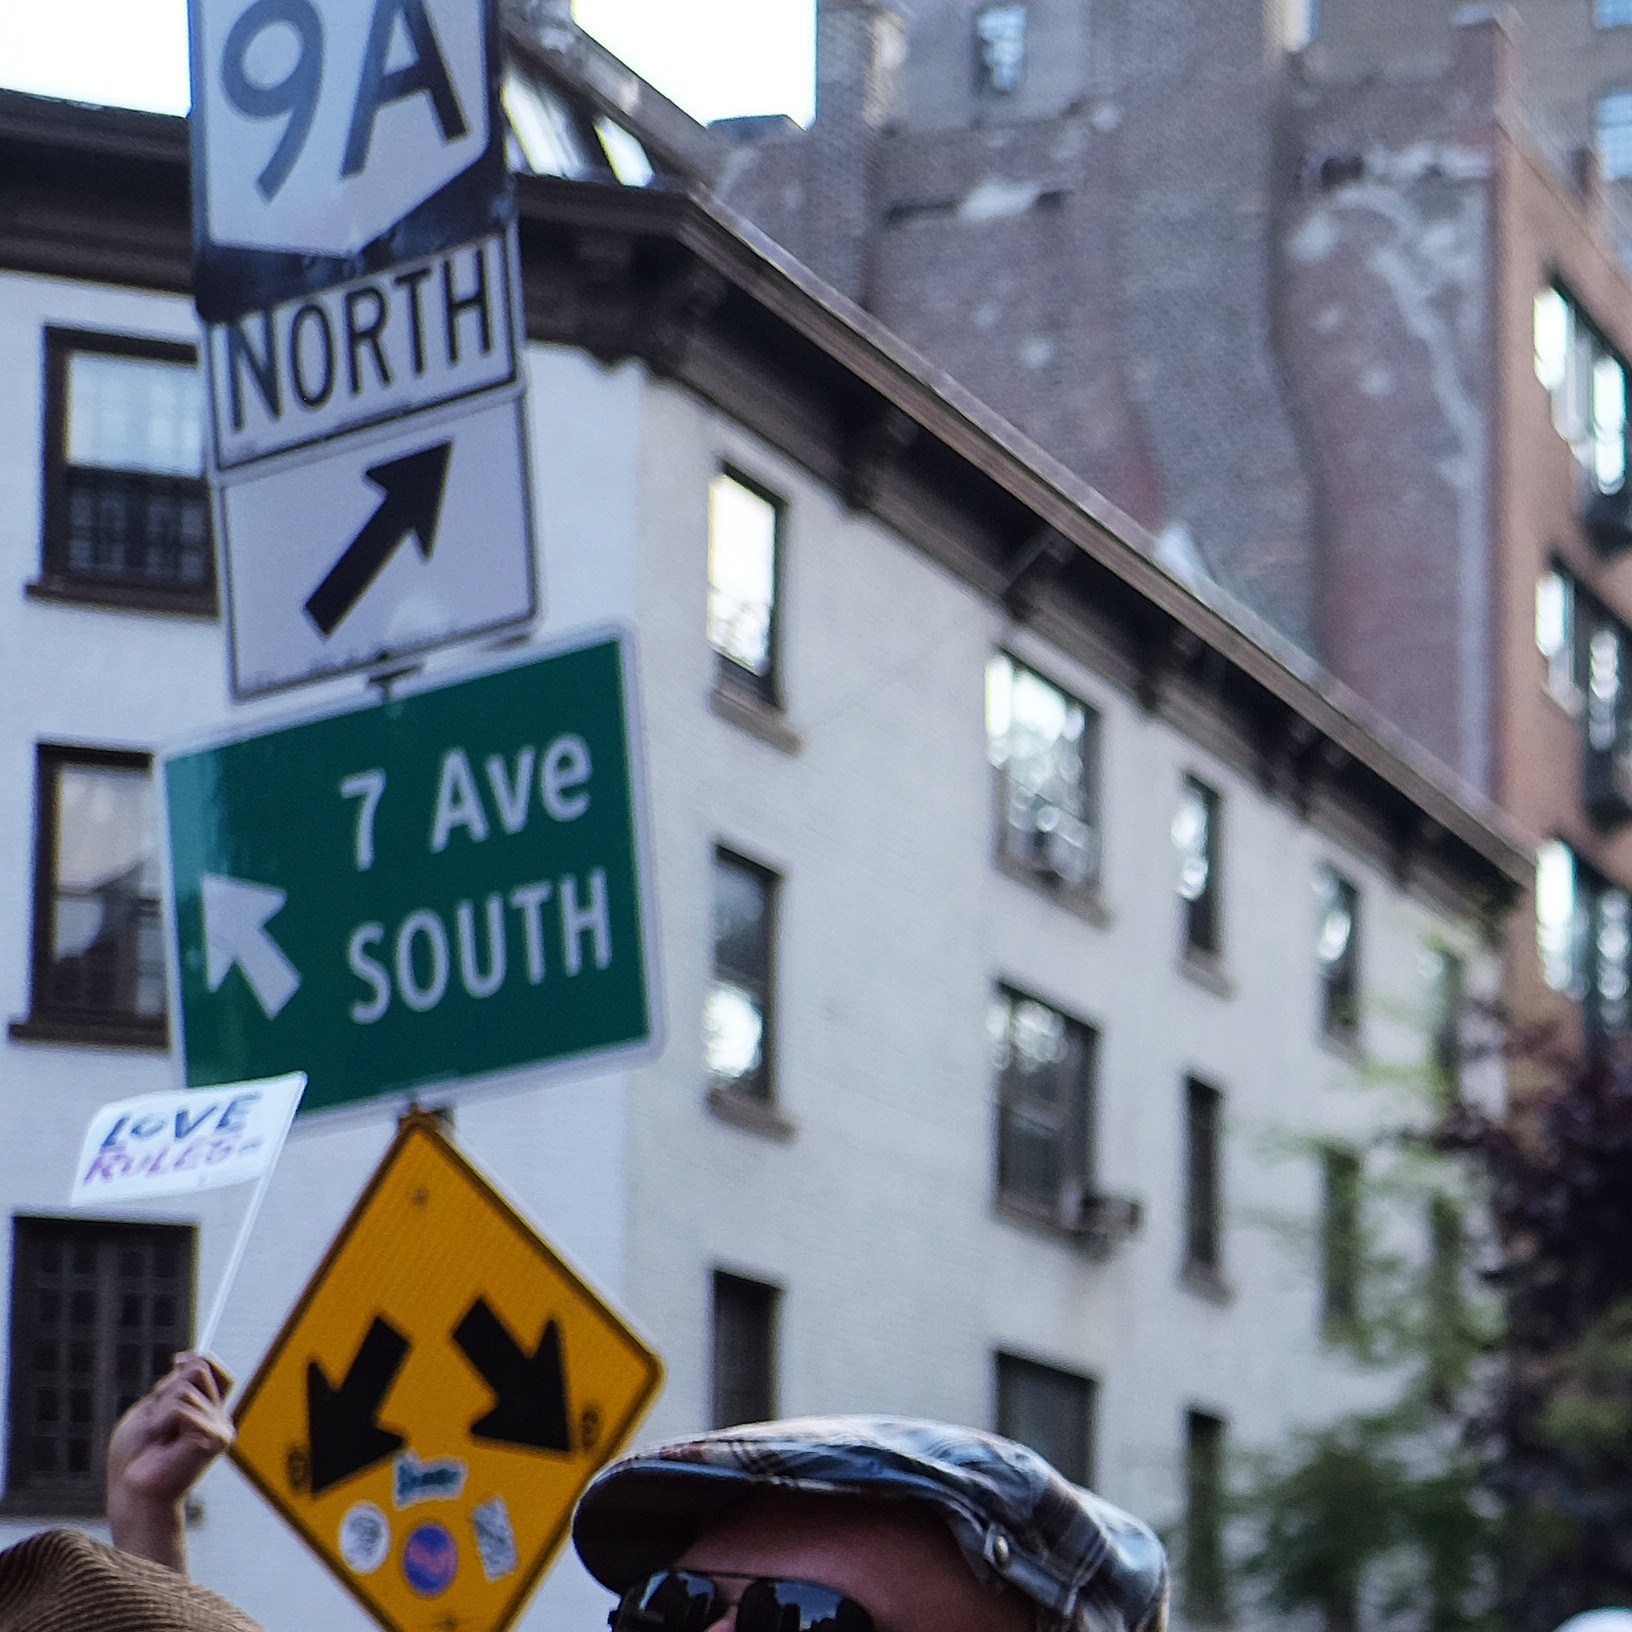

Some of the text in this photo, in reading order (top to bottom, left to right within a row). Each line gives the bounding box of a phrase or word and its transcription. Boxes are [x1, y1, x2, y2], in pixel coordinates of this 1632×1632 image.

[218, 0, 467, 204] 9A
[226, 247, 493, 431] NORTH
[339, 731, 593, 872] 7 Ave
[347, 865, 614, 1026] SOUTH
[101, 1091, 261, 1148] LOVE
